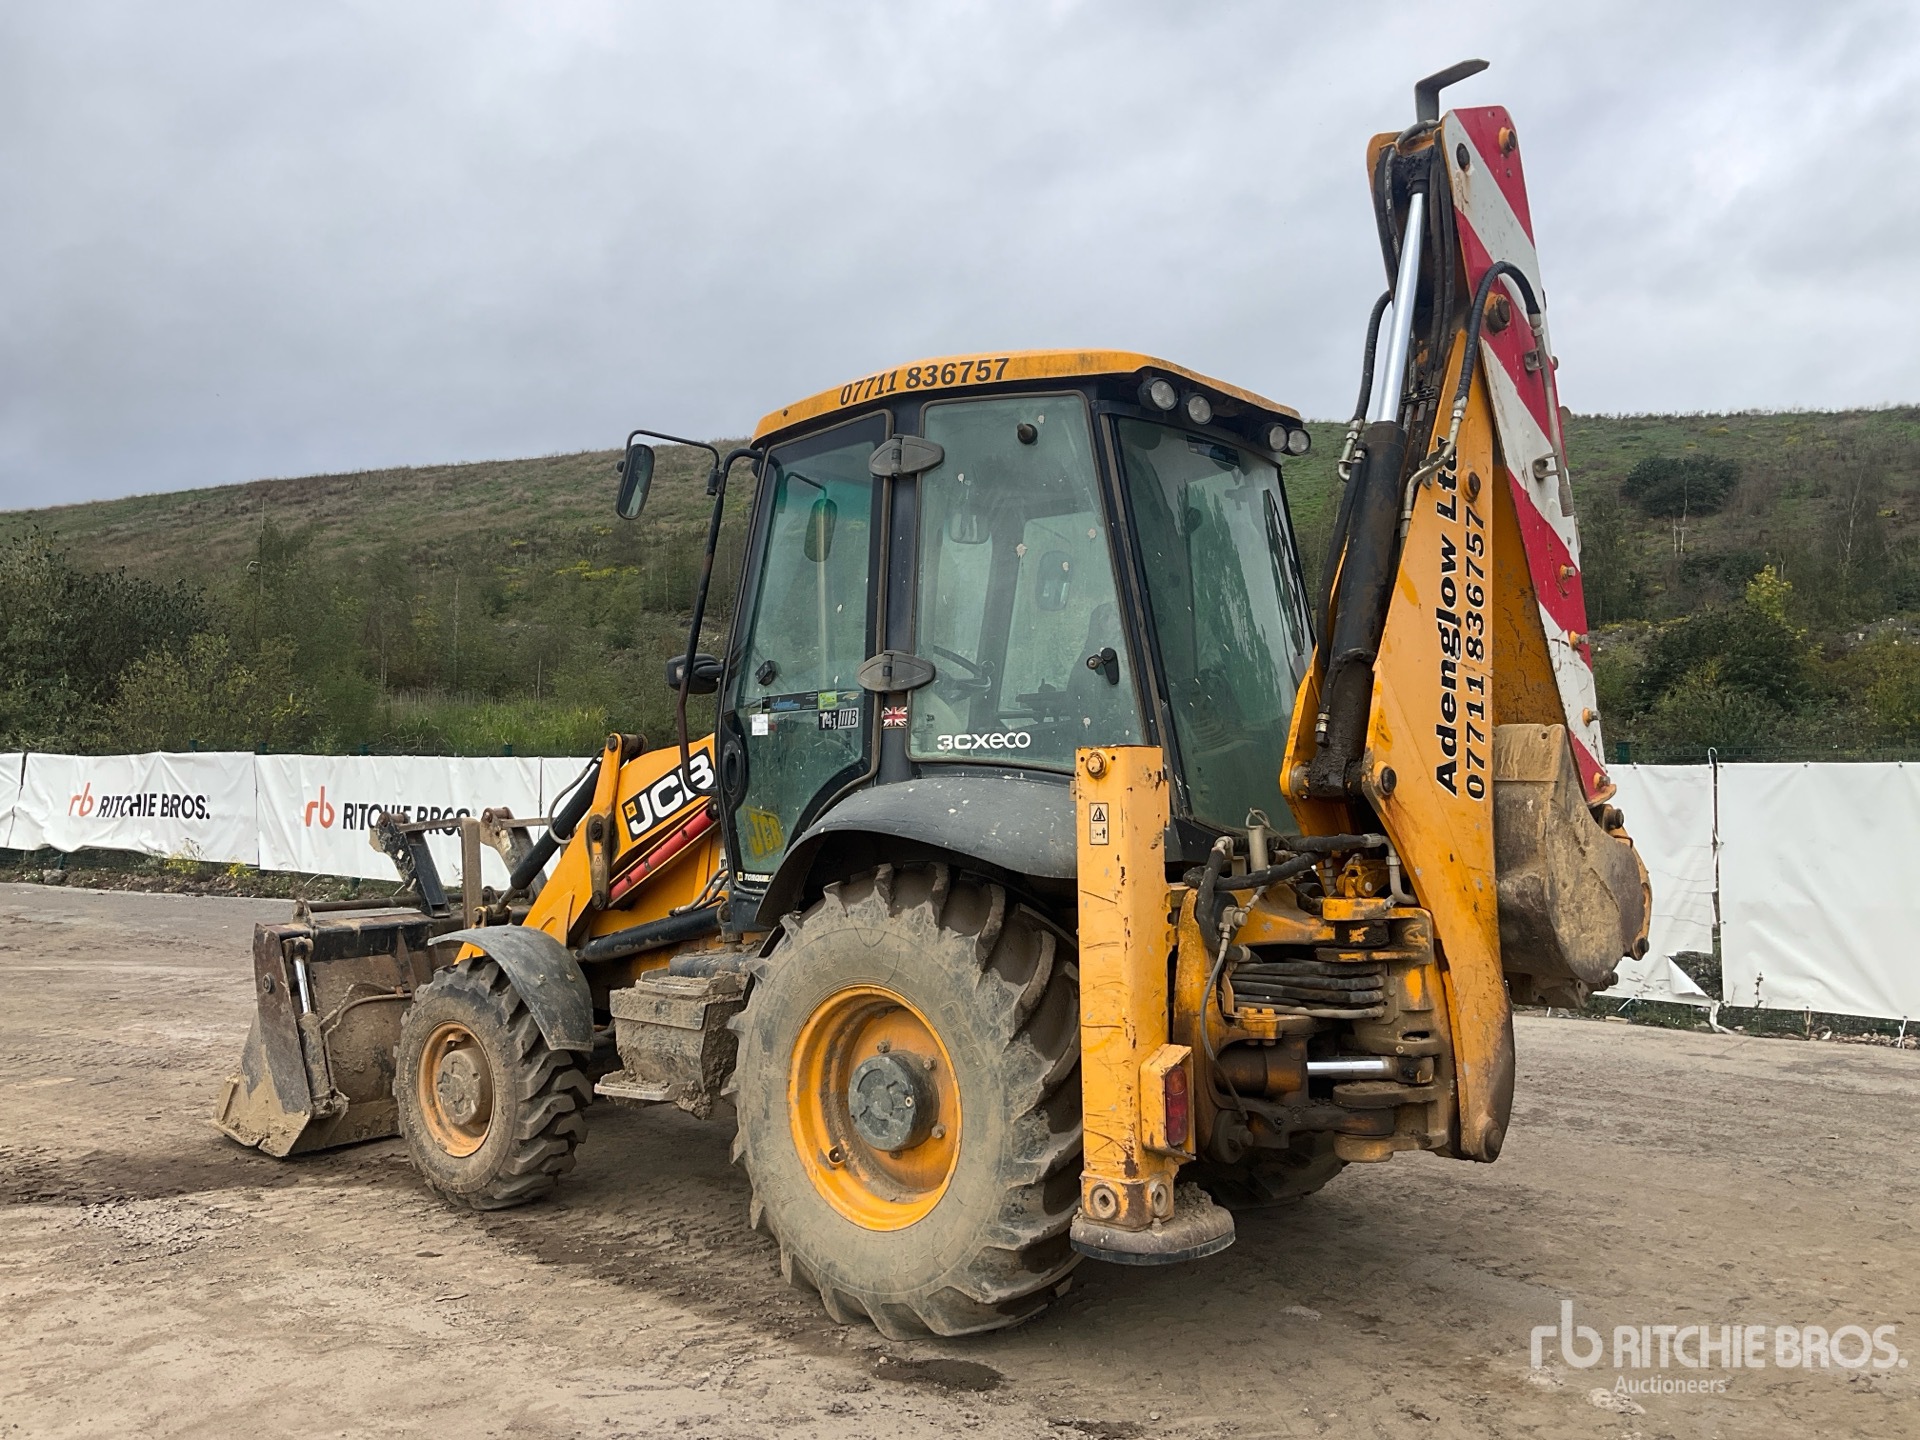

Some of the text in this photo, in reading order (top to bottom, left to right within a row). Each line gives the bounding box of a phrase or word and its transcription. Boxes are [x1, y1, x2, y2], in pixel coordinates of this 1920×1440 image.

[840, 358, 1009, 405] 07711 836757
[1436, 534, 1461, 797] Adenglow
[1466, 505, 1485, 801] 07711 836757
[937, 732, 1031, 750] 3CXeco
[96, 793, 158, 818] RITCHIE
[629, 754, 714, 835] JCB
